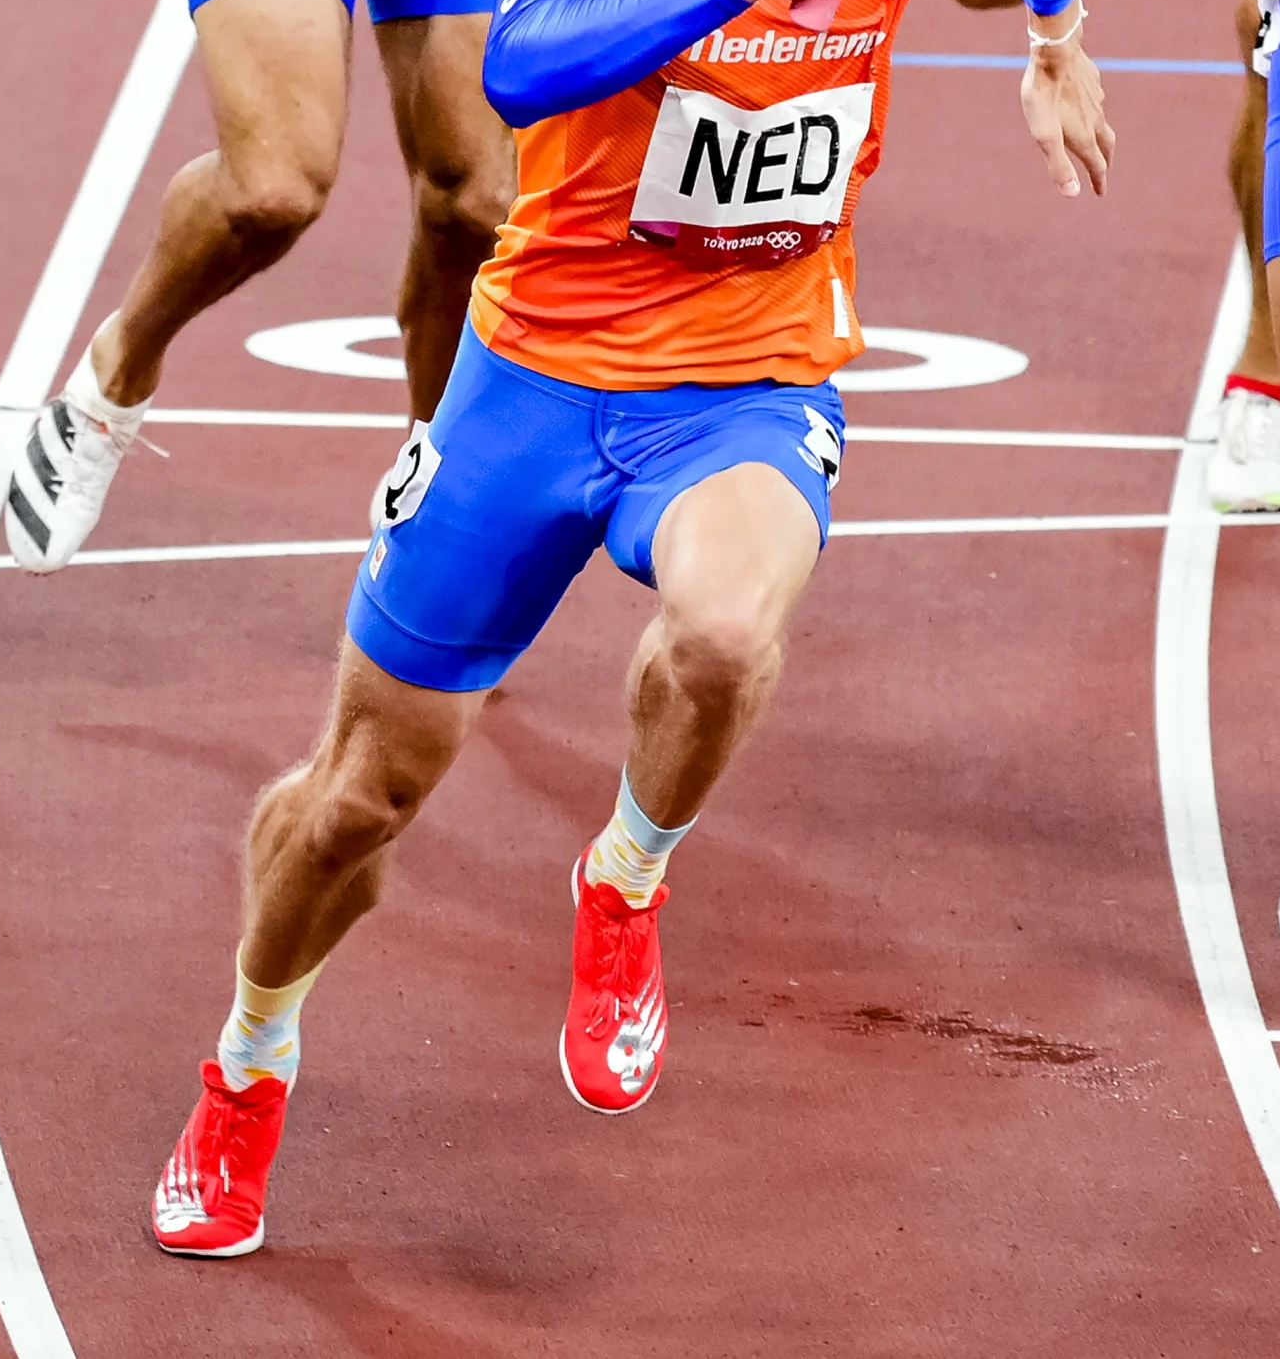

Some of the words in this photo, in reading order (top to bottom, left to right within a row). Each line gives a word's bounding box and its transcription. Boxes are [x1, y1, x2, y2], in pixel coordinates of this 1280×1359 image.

[678, 113, 841, 205] NED
[703, 236, 738, 251] TOKYO
[739, 235, 764, 249] 2020
